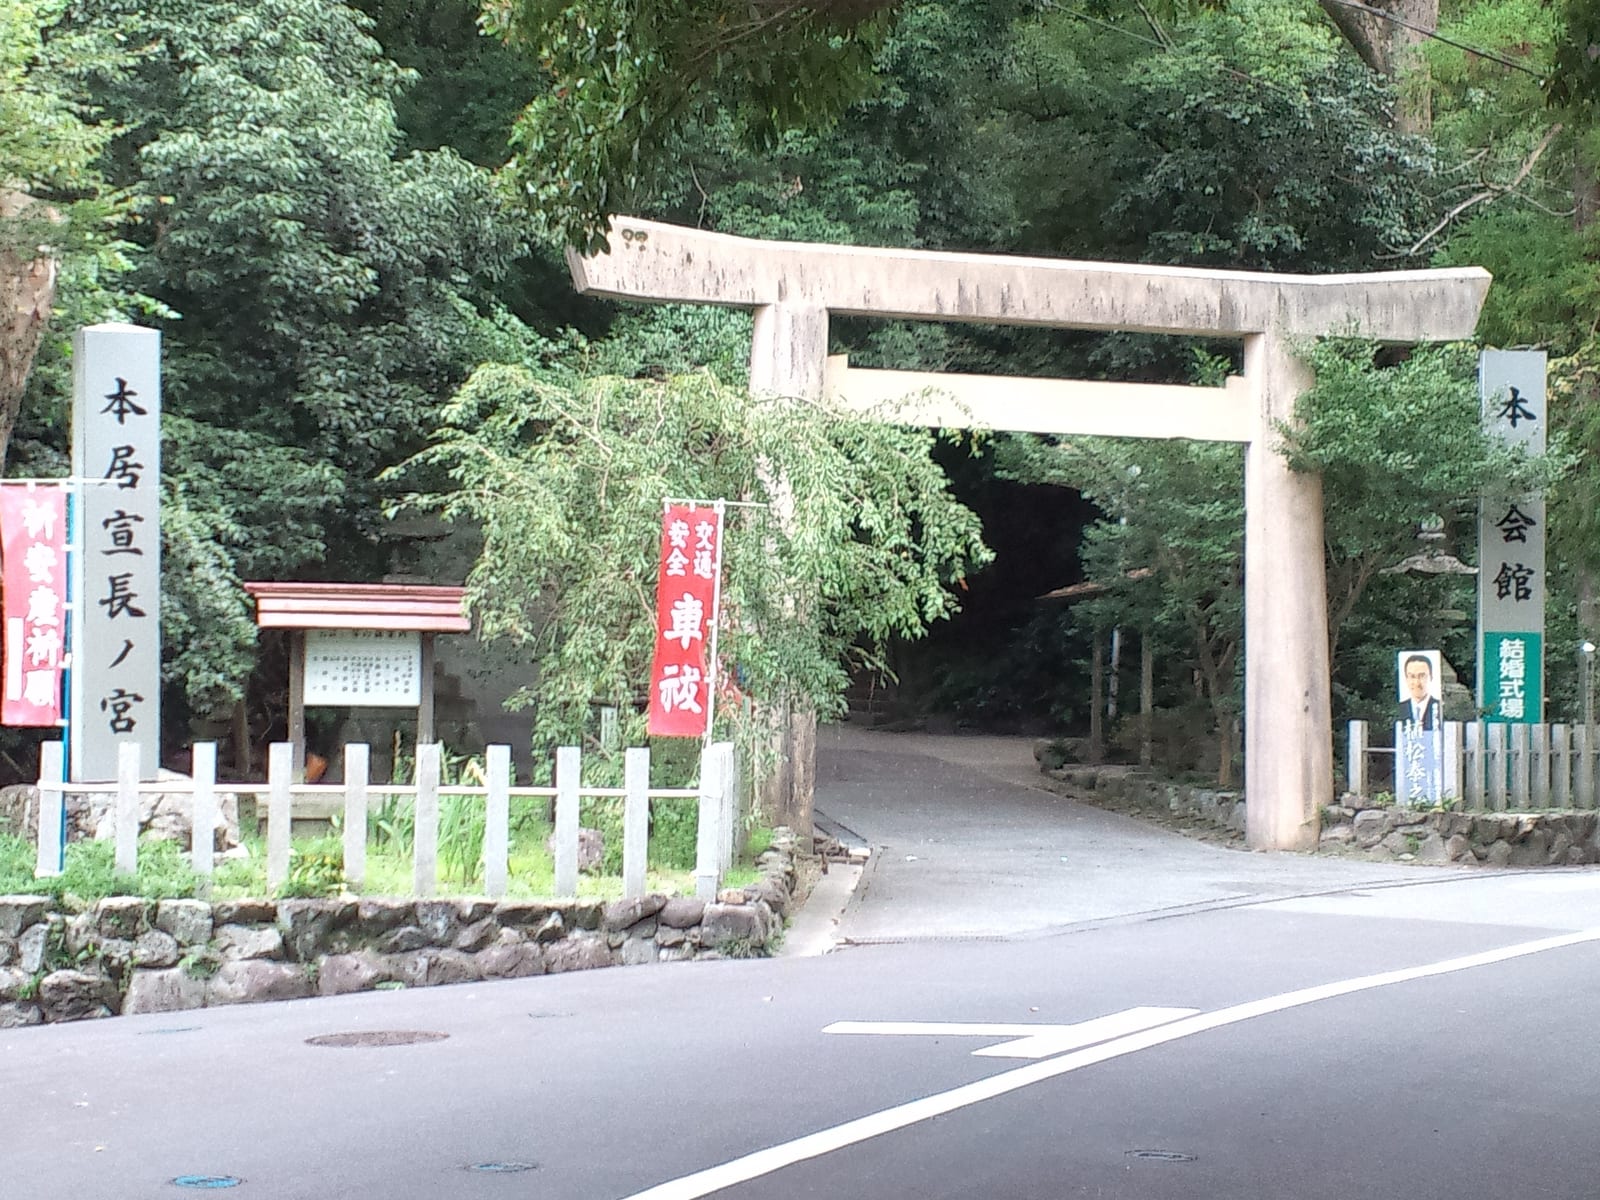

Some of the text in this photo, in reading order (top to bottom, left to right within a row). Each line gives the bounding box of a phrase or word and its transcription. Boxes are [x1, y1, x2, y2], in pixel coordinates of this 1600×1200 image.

[1493, 386, 1537, 603] 本会館
[99, 377, 147, 734] 本居宣長ノ宮
[666, 518, 690, 577] 安全
[692, 520, 714, 580] 交通
[1499, 638, 1525, 719] 結婚式場
